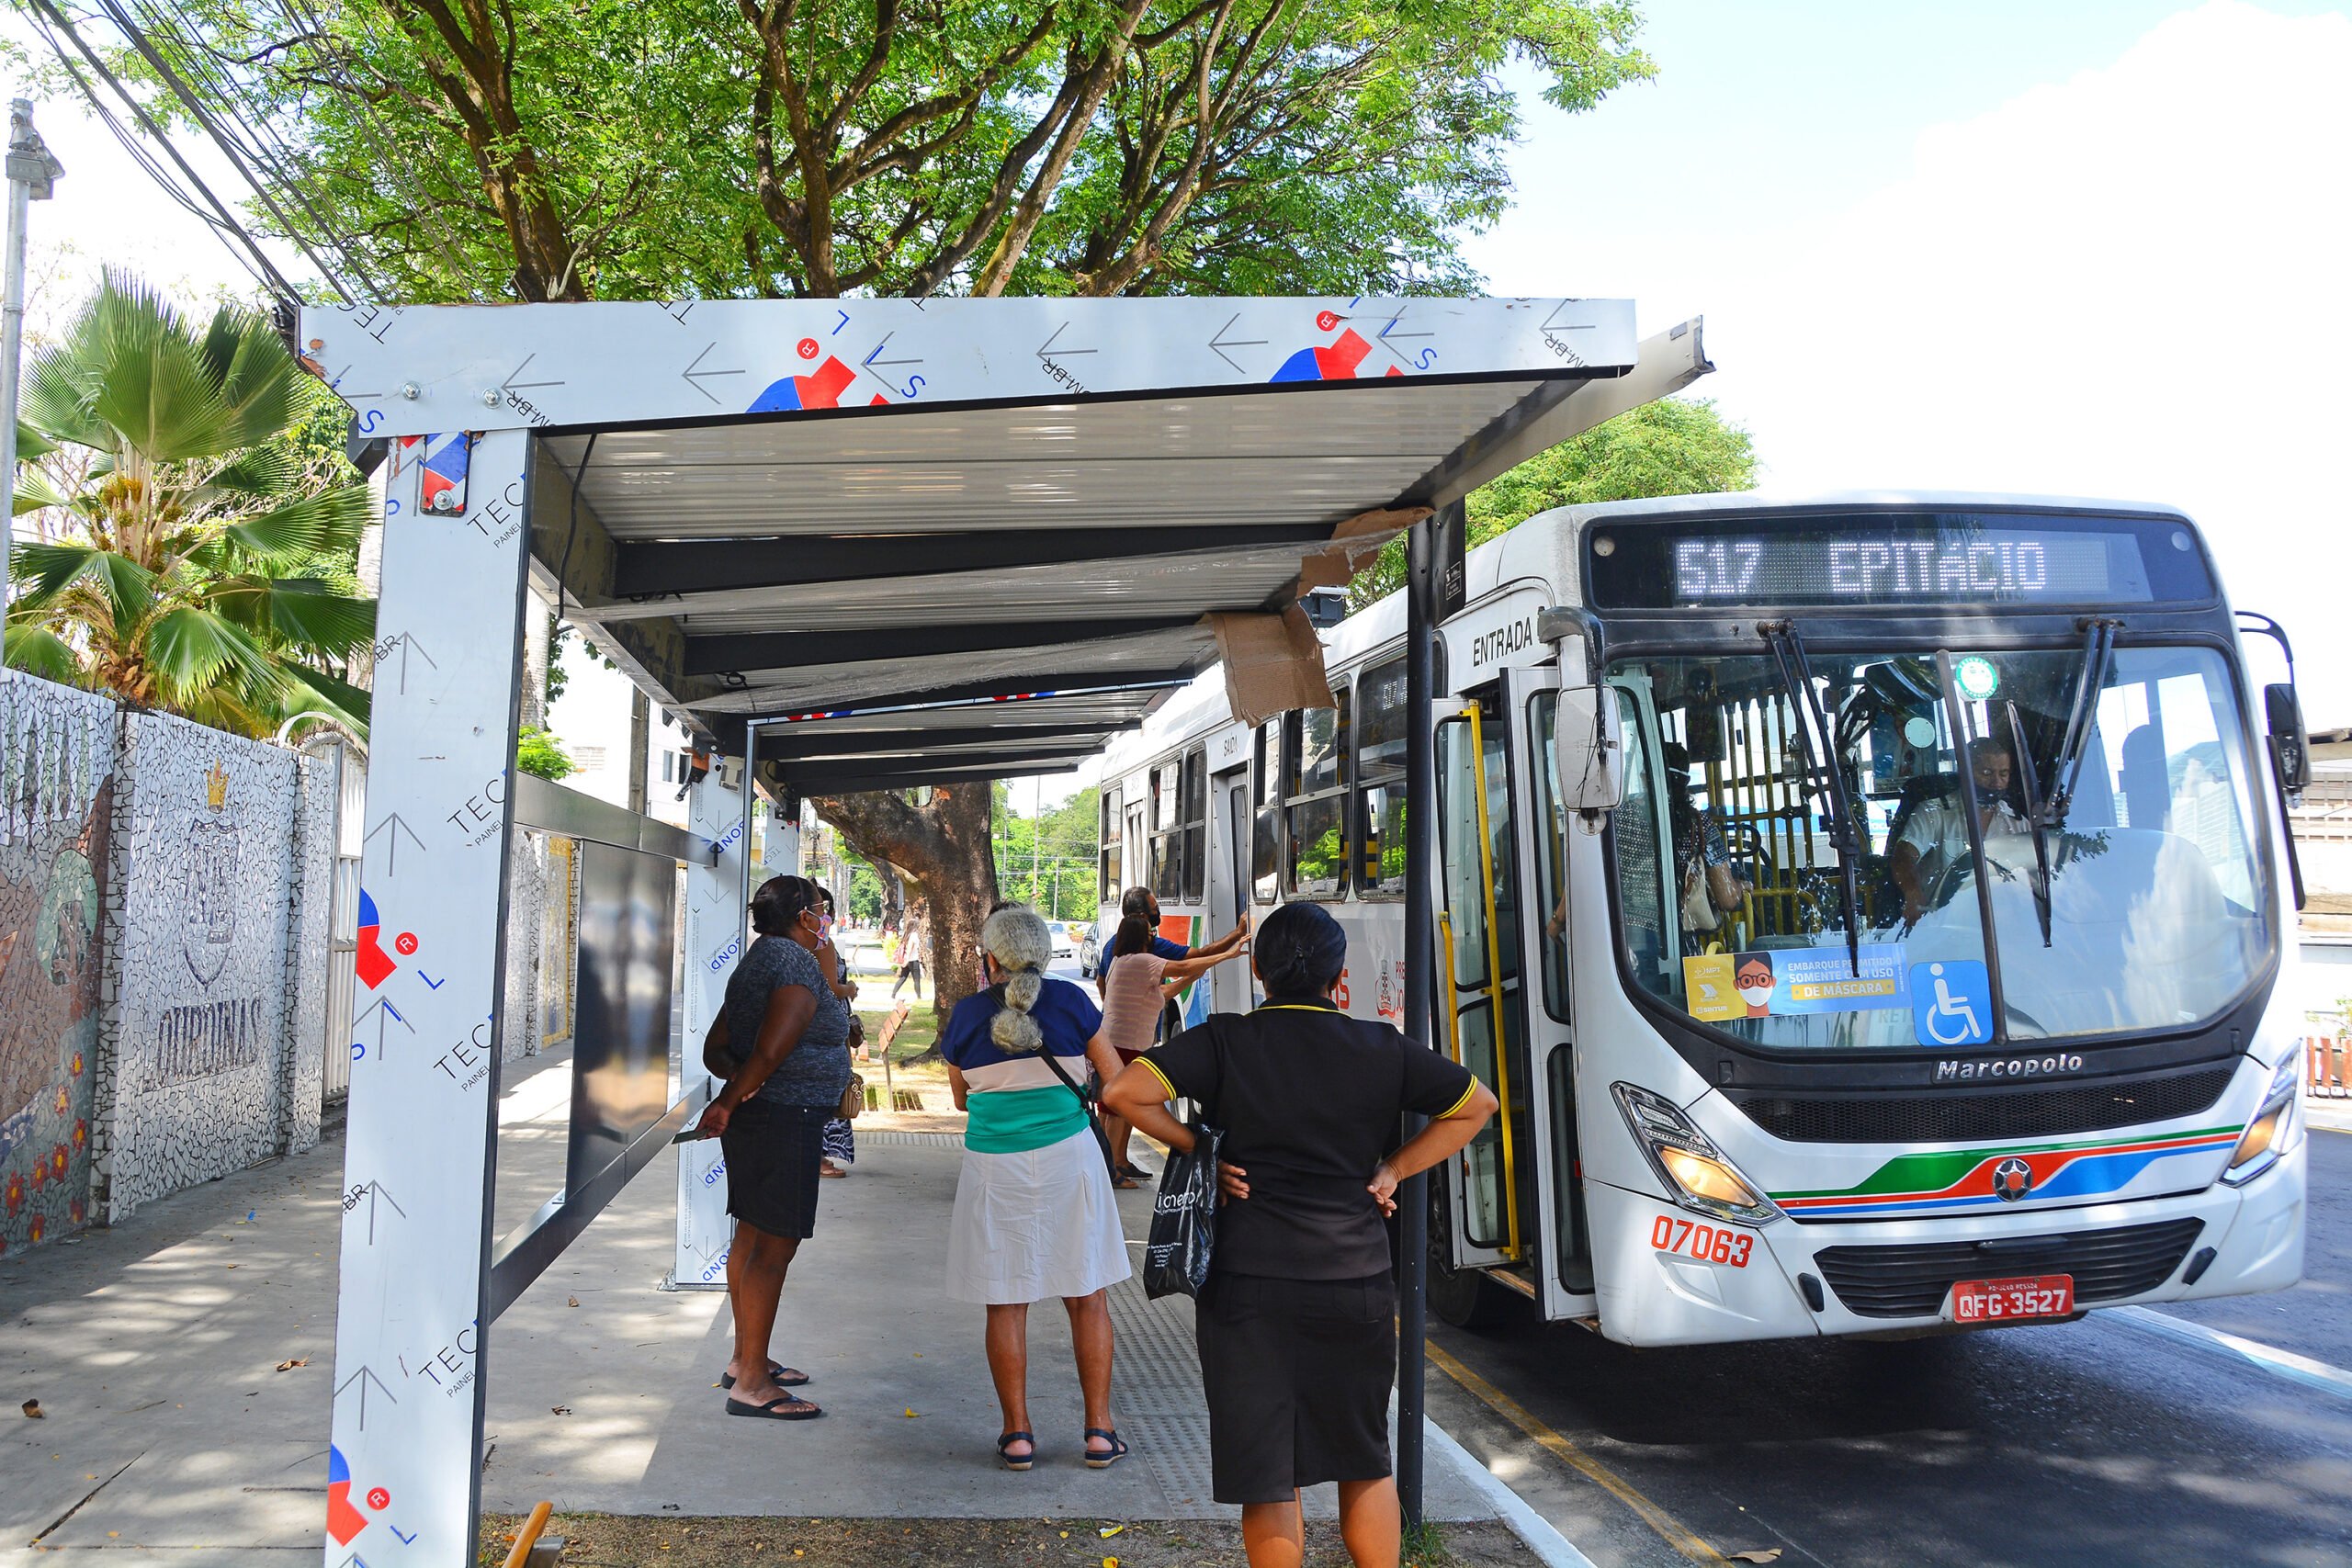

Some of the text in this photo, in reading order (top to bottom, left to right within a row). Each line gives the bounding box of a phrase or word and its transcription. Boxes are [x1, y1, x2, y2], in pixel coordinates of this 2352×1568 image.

[1544, 333, 1589, 368] M.BR
[1042, 357, 1091, 396] M.BR
[506, 390, 556, 427] M.BR
[1677, 541, 2047, 594] 517 EPITÁCIO
[1473, 616, 1533, 668] ENTRADA
[1787, 957, 1894, 972] EMBARQUE PEMITIDO
[1788, 967, 1894, 984] SOMENTE CM USO
[1804, 981, 1884, 998] DE MÁSCARA
[1936, 1054, 2083, 1080] Marcopolo
[1651, 1214, 1754, 1269] 07063
